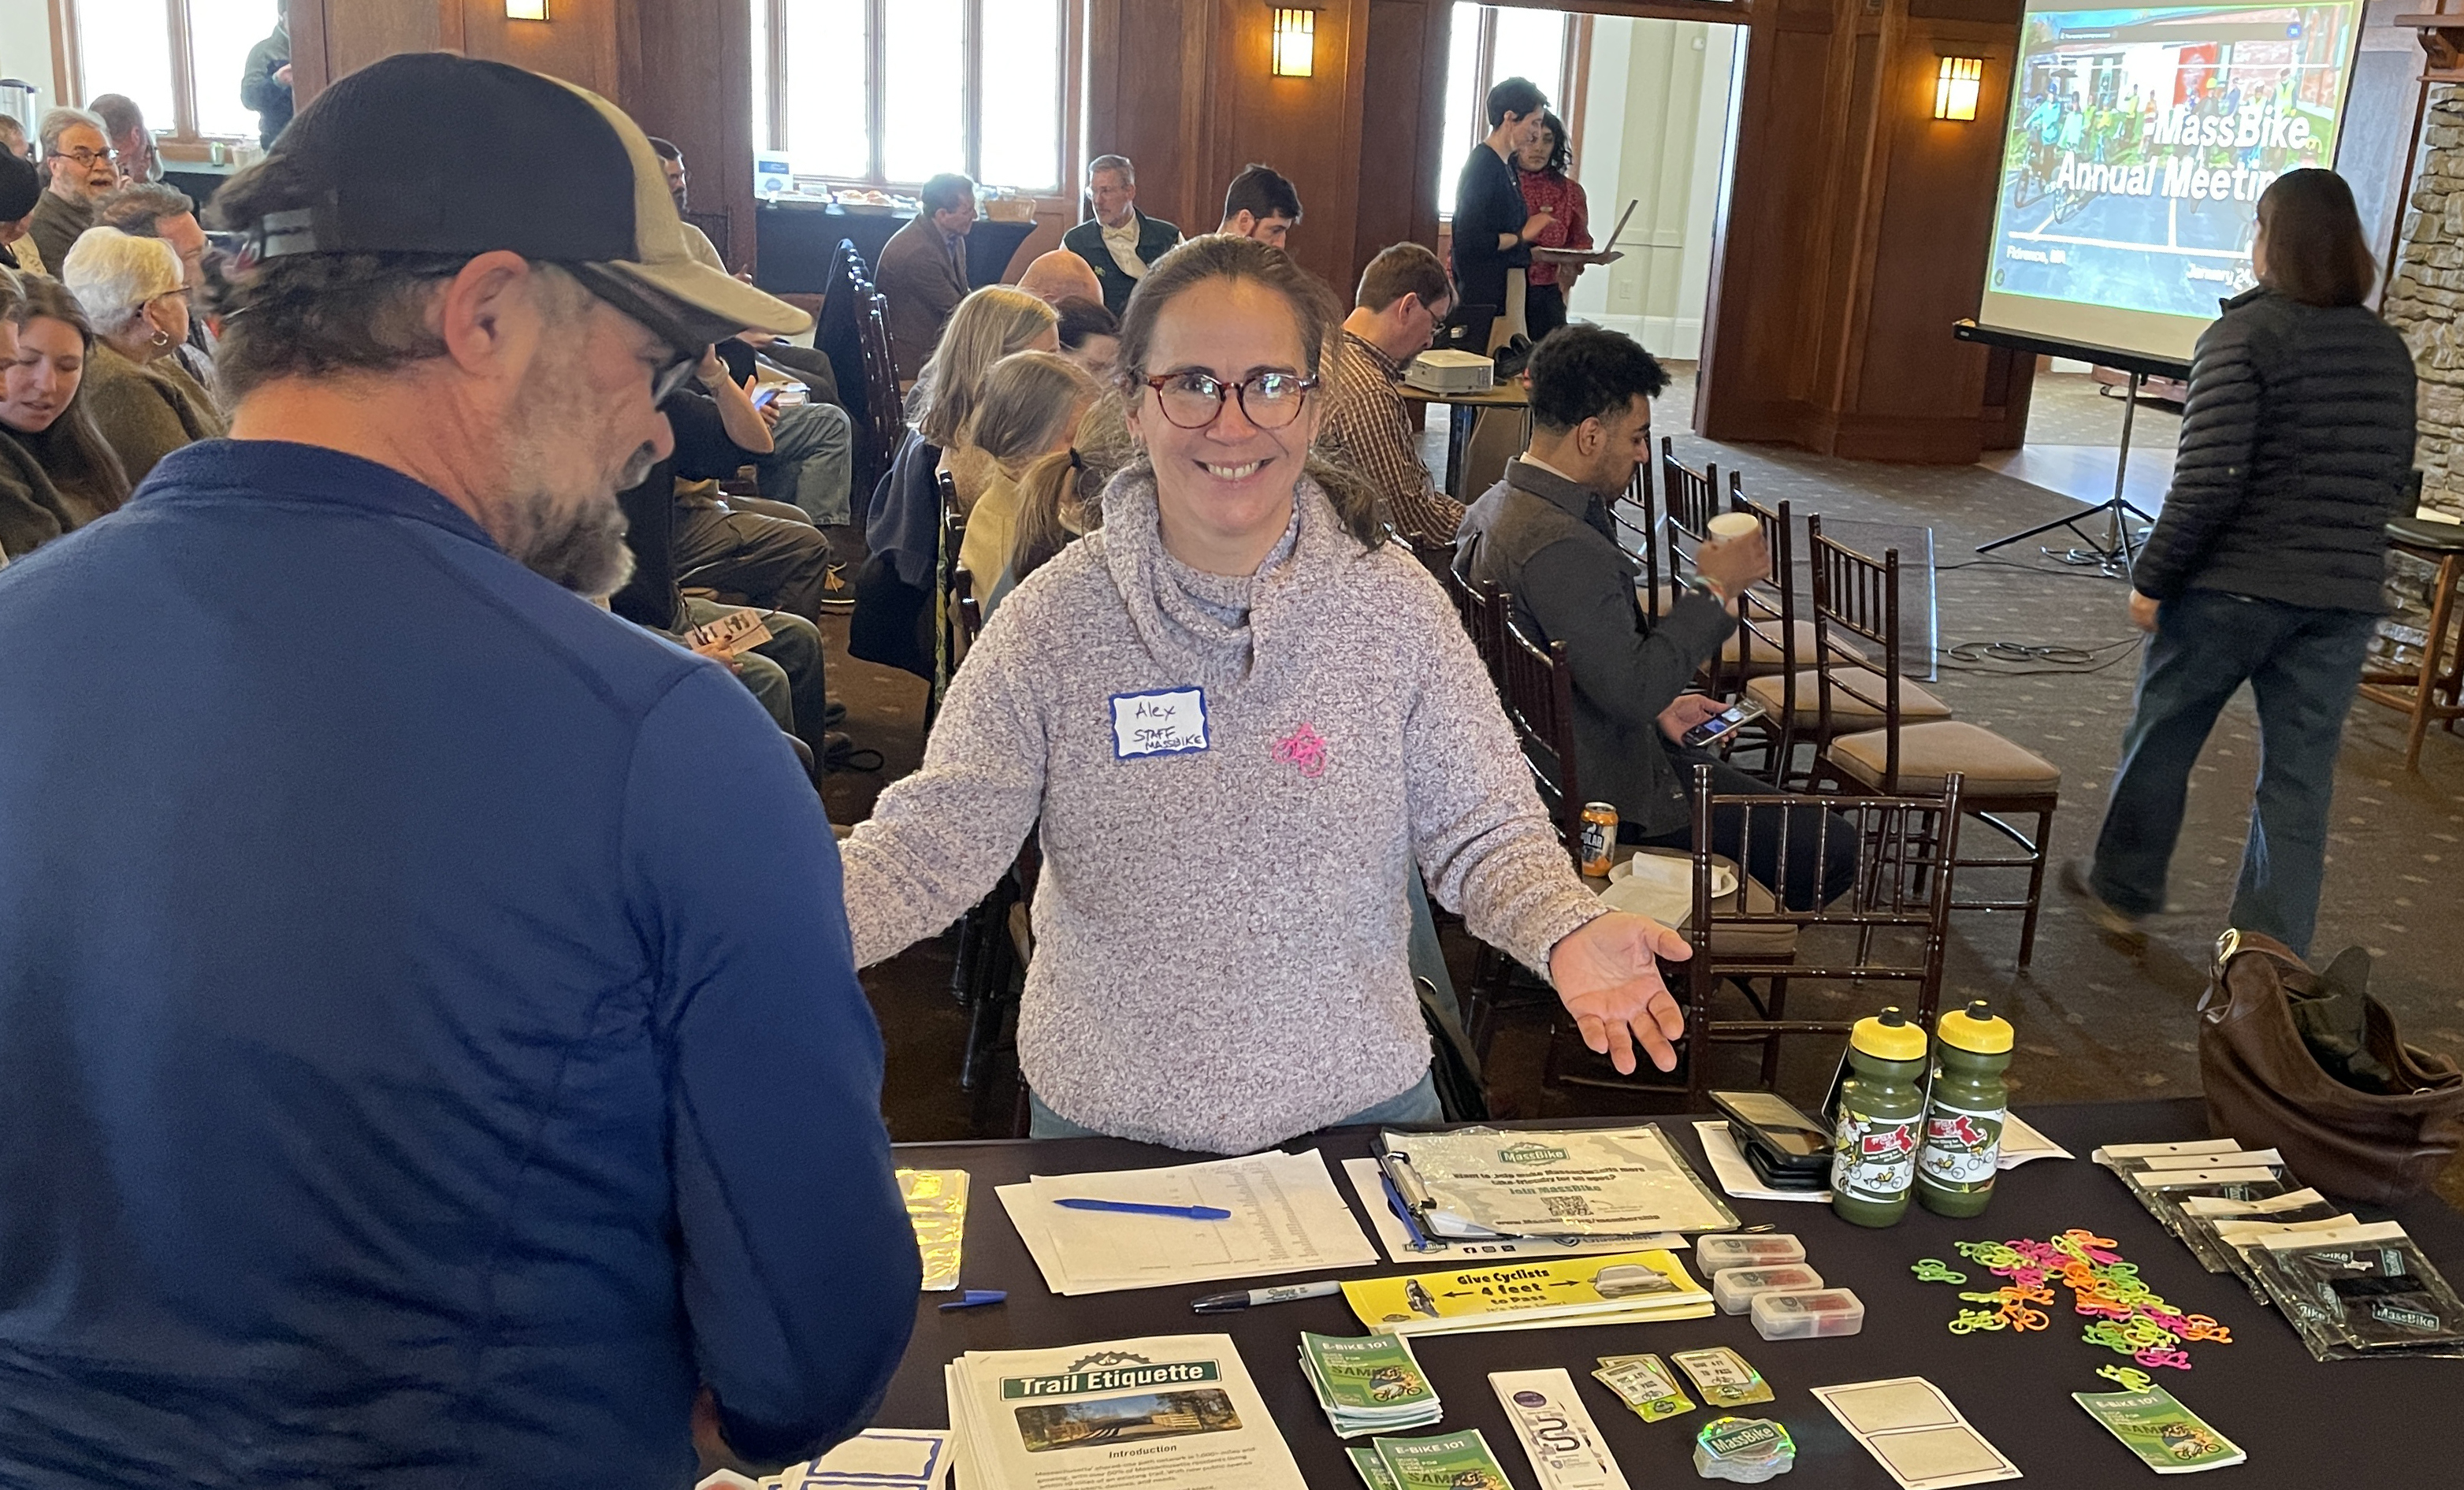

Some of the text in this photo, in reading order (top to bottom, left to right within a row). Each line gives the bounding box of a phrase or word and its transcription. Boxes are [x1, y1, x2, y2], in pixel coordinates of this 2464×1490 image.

[2153, 103, 2310, 150] MassBike
[2056, 154, 2277, 201] Annual Meetin
[1136, 701, 1176, 721] Alex
[1132, 726, 1176, 742] STAFF
[1503, 1150, 1564, 1163] MassBike
[1458, 1269, 1551, 1285] Give Cyclists
[2377, 1307, 2435, 1328] MassBike
[1322, 1340, 1388, 1351] E-BIKE 101
[1020, 1364, 1205, 1395] Trail Etiquette
[2138, 1396, 2159, 1406] 101
[1395, 1440, 1466, 1455] E-BIKE 101
[1711, 1427, 1775, 1453] MassBike
[1109, 1444, 1178, 1459] Introduction
